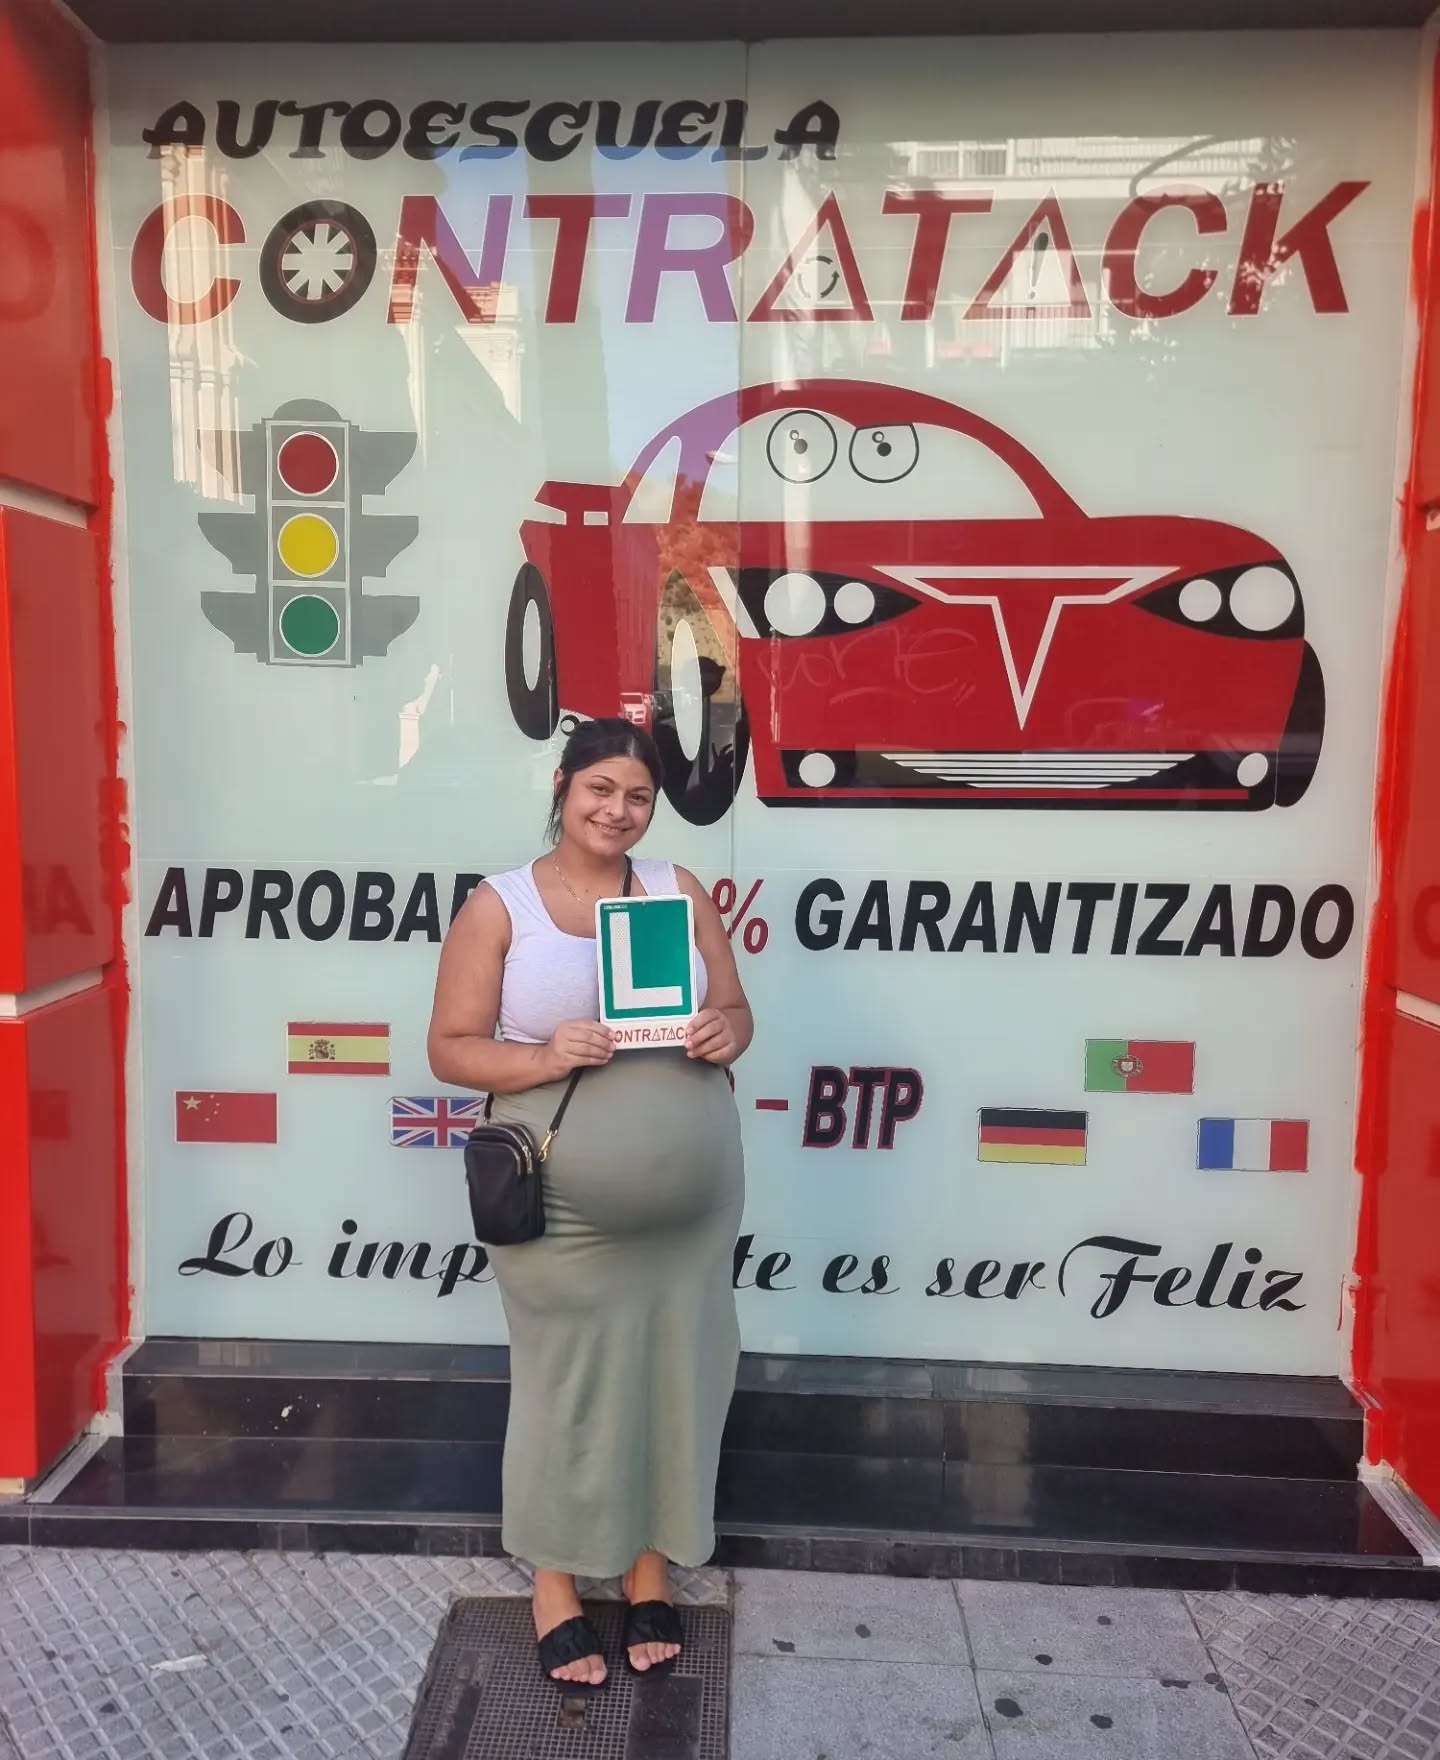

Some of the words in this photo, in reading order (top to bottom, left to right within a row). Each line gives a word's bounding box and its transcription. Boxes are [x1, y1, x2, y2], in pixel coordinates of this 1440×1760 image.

[142, 99, 841, 164] AUTOESCUELA
[130, 181, 1371, 325] CONTRATACK
[609, 911, 683, 1010] L
[794, 877, 1355, 960] GARANTIZADO
[801, 1065, 924, 1150] BTP
[179, 1211, 303, 1278] Lo
[821, 1251, 901, 1297] es
[925, 1254, 1048, 1299] ser
[1057, 1234, 1307, 1320] Feliz
